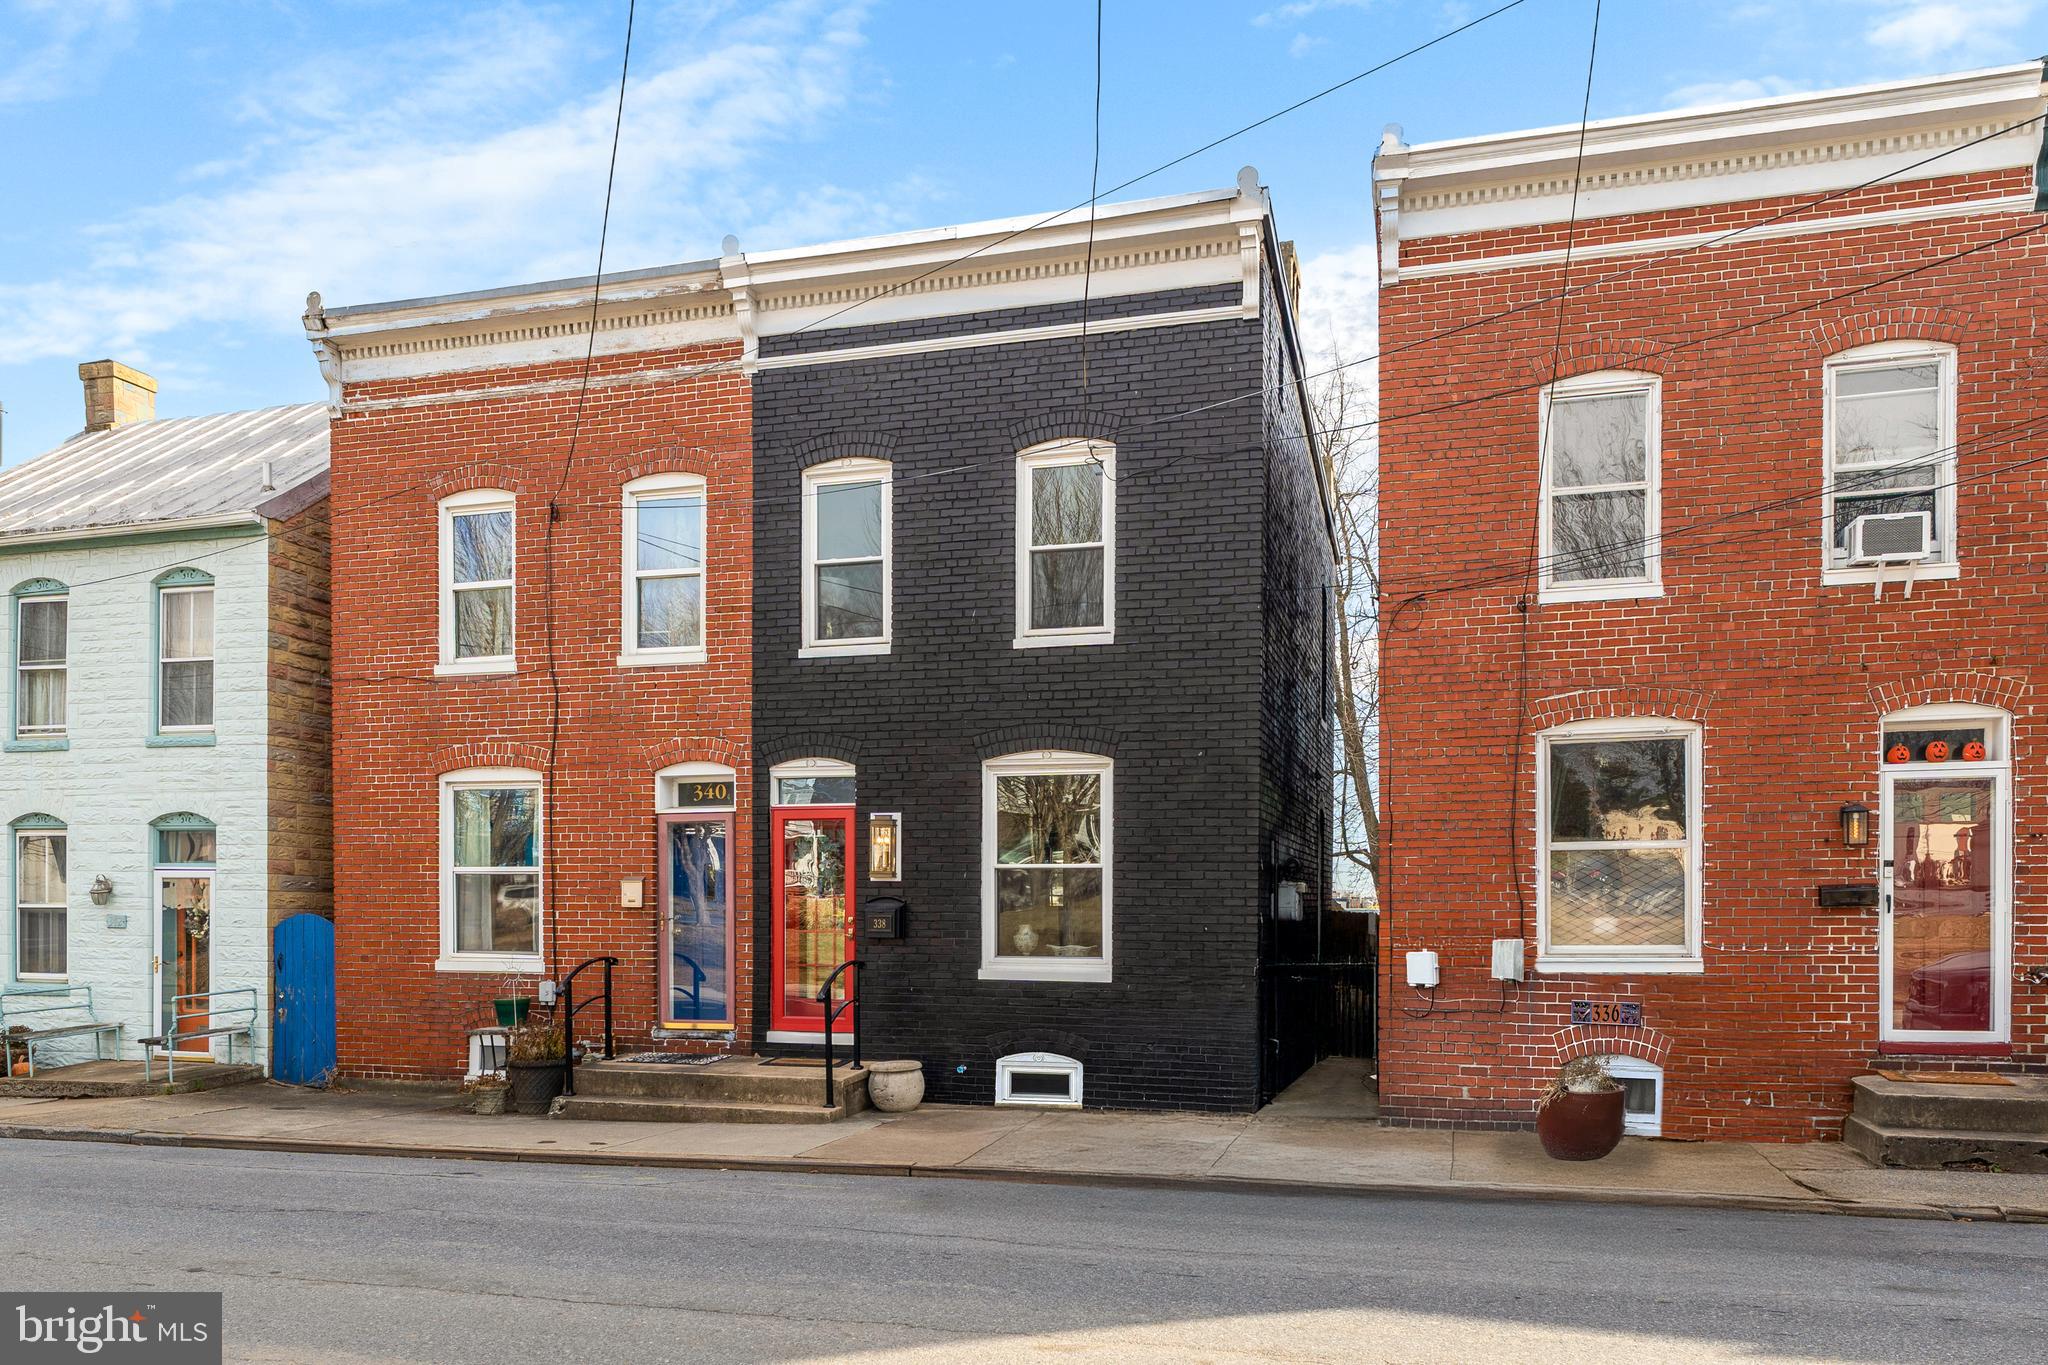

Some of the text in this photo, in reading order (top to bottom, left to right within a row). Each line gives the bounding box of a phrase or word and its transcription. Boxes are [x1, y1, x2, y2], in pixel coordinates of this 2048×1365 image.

[693, 783, 727, 802] 340
[873, 919, 887, 929] 338
[1592, 1004, 1620, 1022] 336
